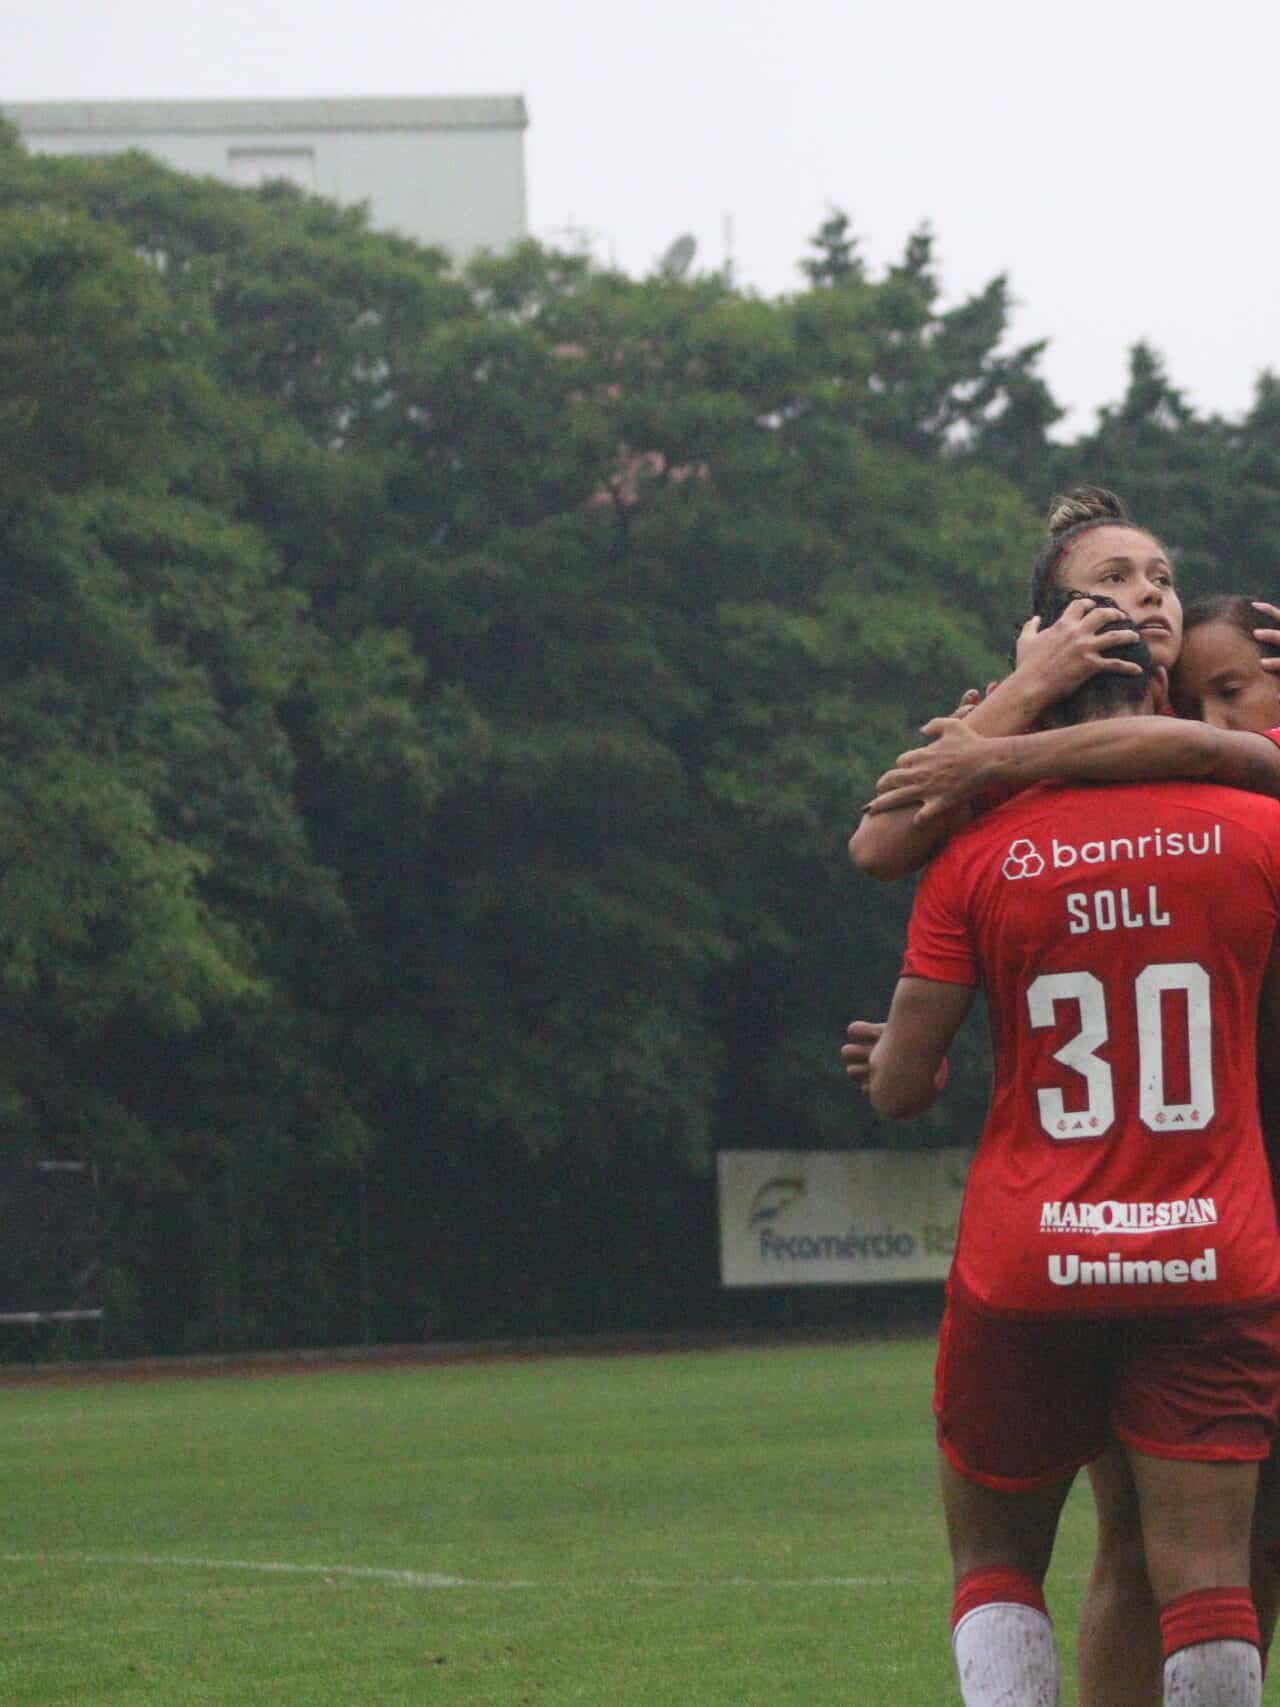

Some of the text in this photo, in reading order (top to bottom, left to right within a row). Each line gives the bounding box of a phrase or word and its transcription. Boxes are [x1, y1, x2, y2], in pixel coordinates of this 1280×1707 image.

[1052, 824, 1221, 868] banrisul
[1066, 885, 1171, 935] SOLL
[1026, 962, 1216, 1140] 30
[1040, 1197, 1218, 1237] MARQUESPAN
[1048, 1247, 1218, 1286] Unimed
